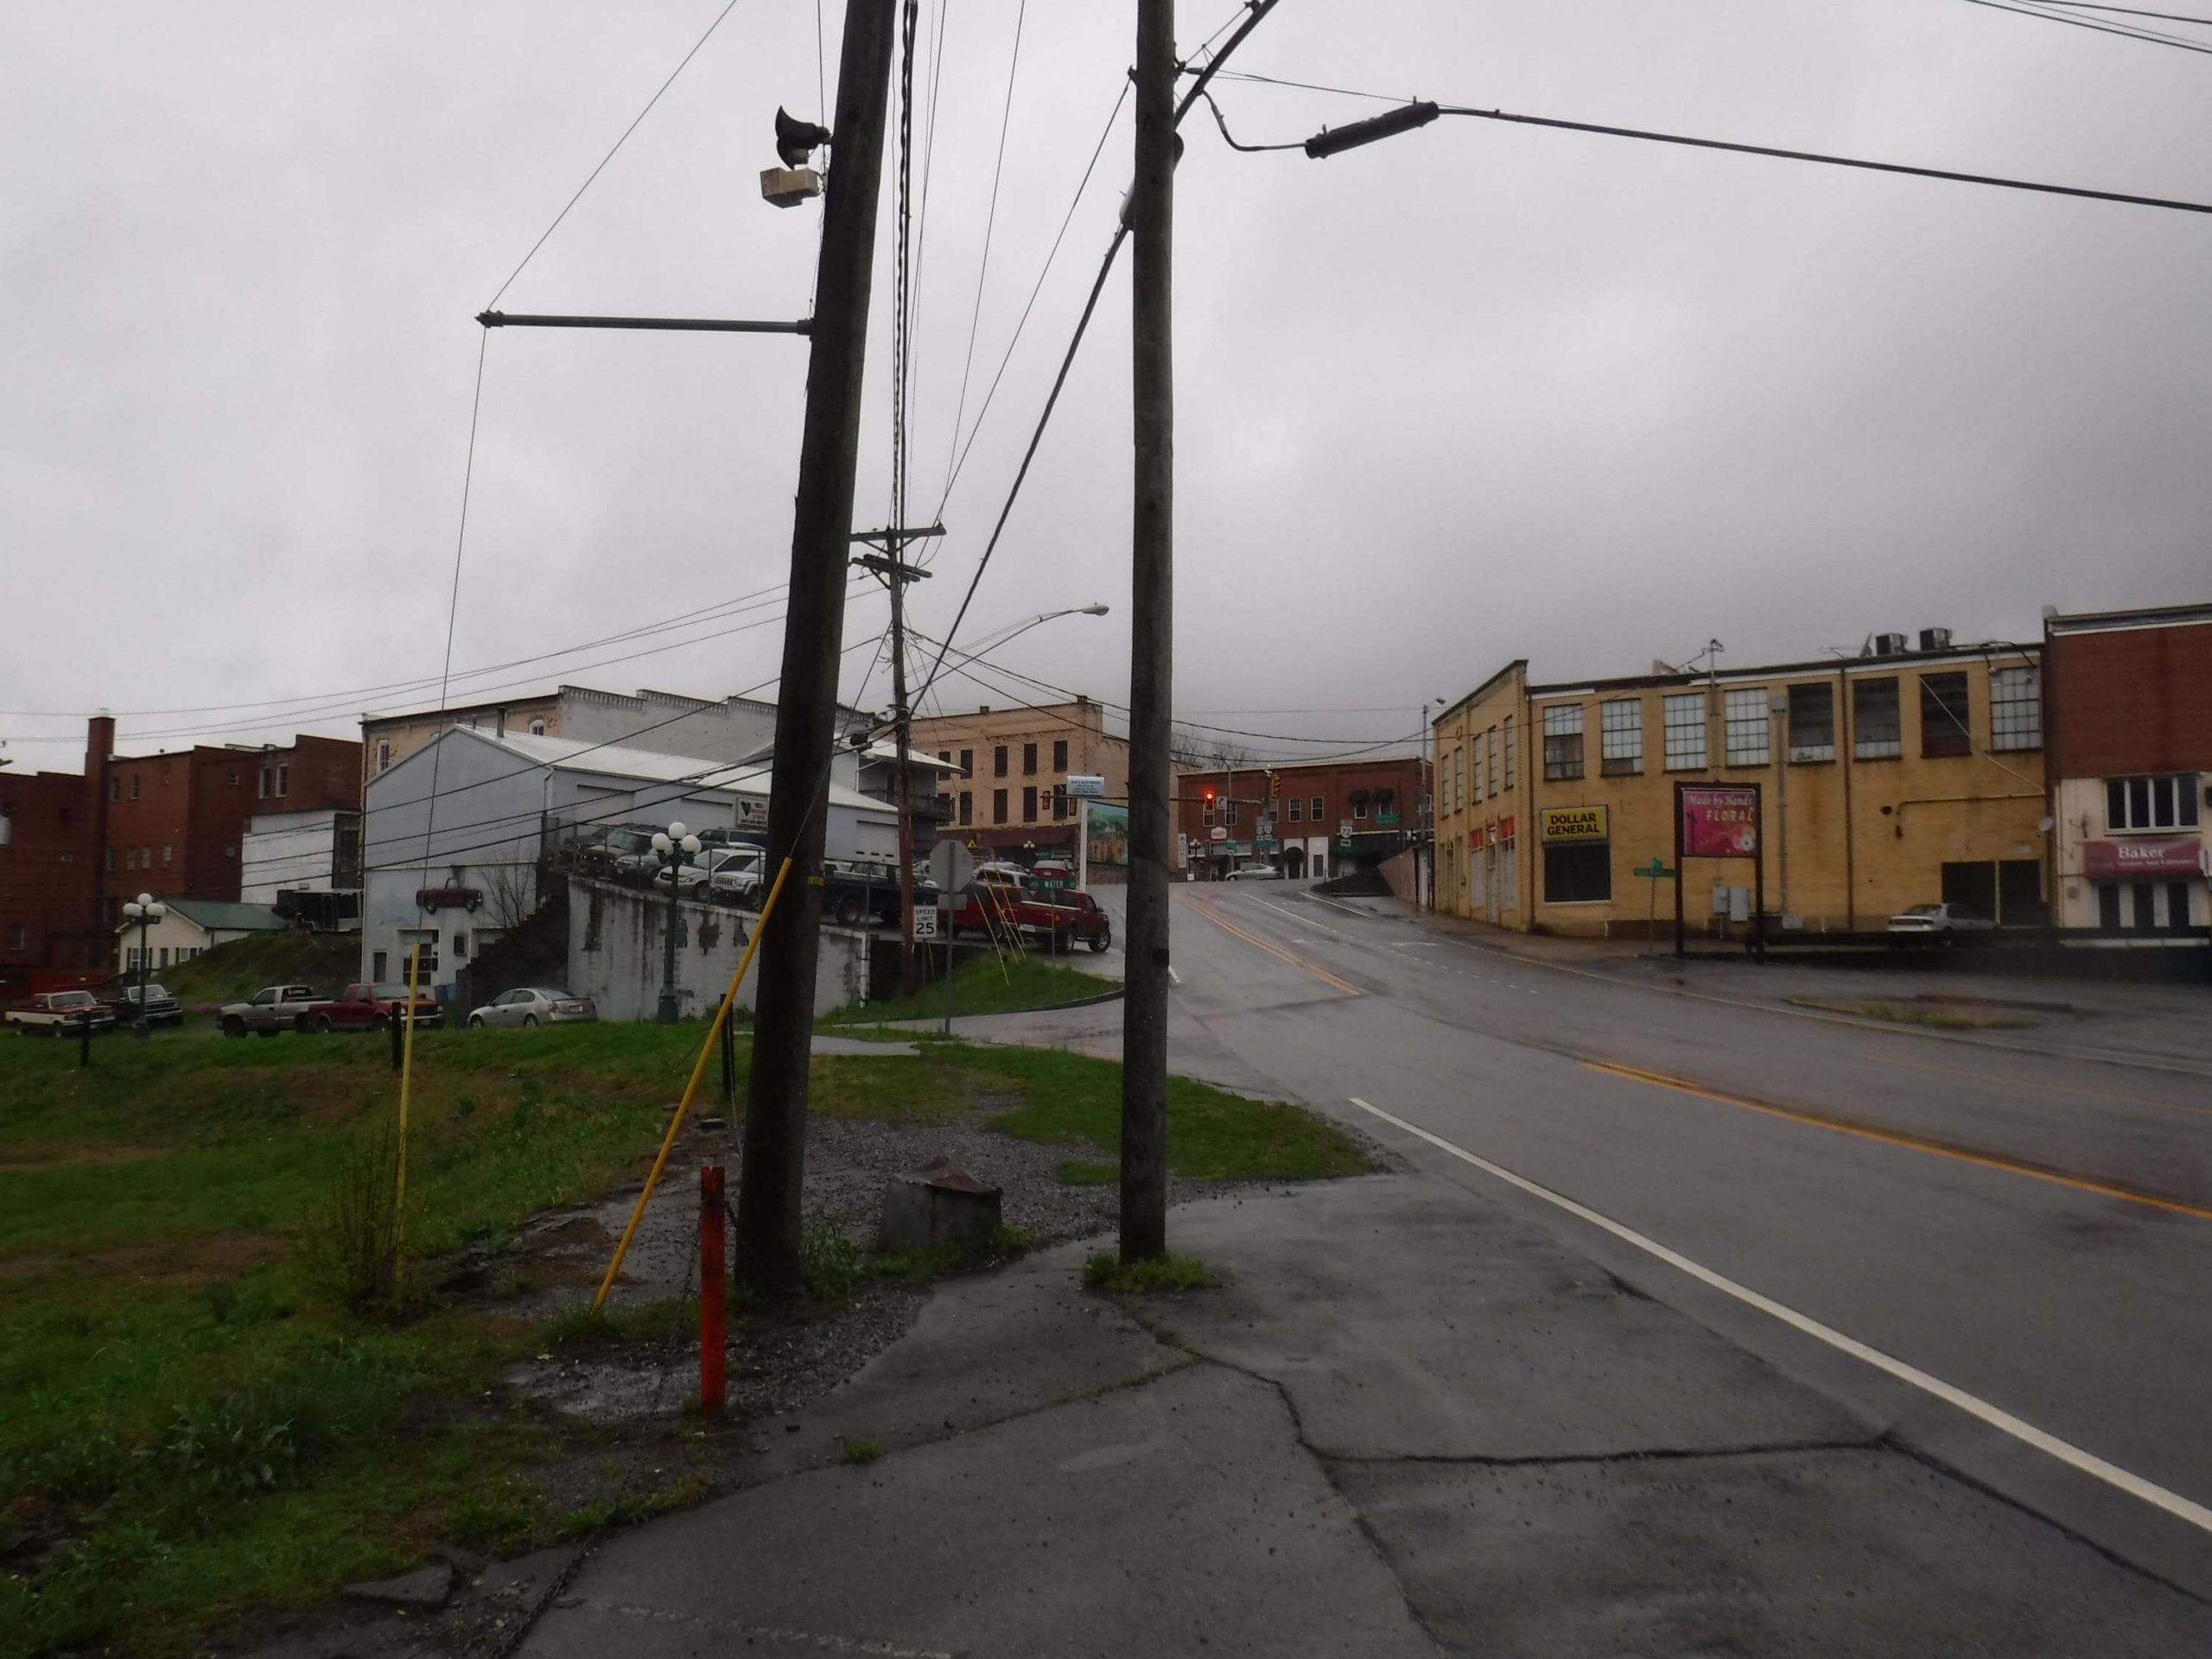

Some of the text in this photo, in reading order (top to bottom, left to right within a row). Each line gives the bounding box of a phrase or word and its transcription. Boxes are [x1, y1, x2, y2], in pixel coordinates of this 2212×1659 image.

[1713, 793, 1722, 809] by
[1550, 813, 1598, 824] DOLLAR
[1706, 809, 1753, 822] FLORAL
[1548, 823, 1600, 836] GENERAL
[2119, 847, 2165, 858] Baker
[1044, 880, 1064, 889] WATER
[916, 922, 934, 934] 25
